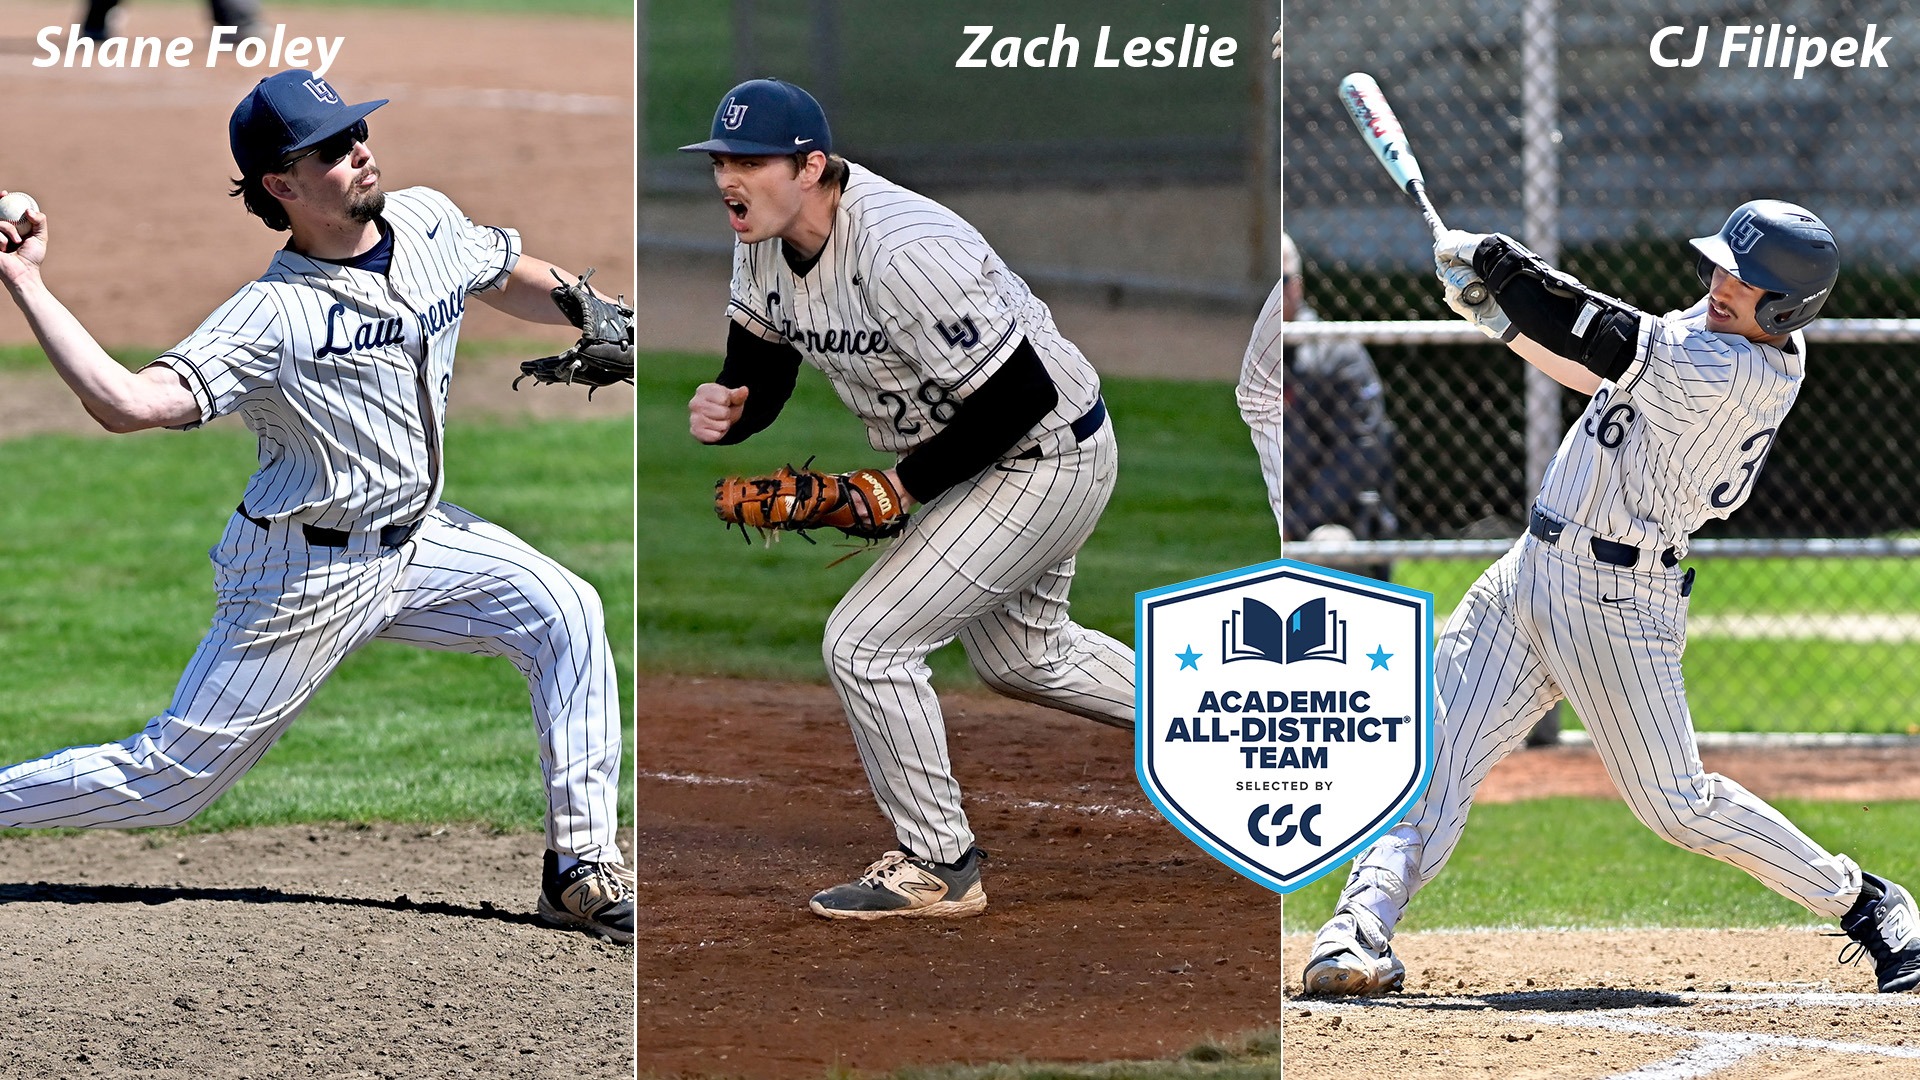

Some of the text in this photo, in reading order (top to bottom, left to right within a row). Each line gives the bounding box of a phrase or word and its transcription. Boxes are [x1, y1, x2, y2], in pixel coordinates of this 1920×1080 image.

[878, 379, 956, 435] 28
[1585, 388, 1636, 448] 36
[862, 472, 892, 515] Wilson
